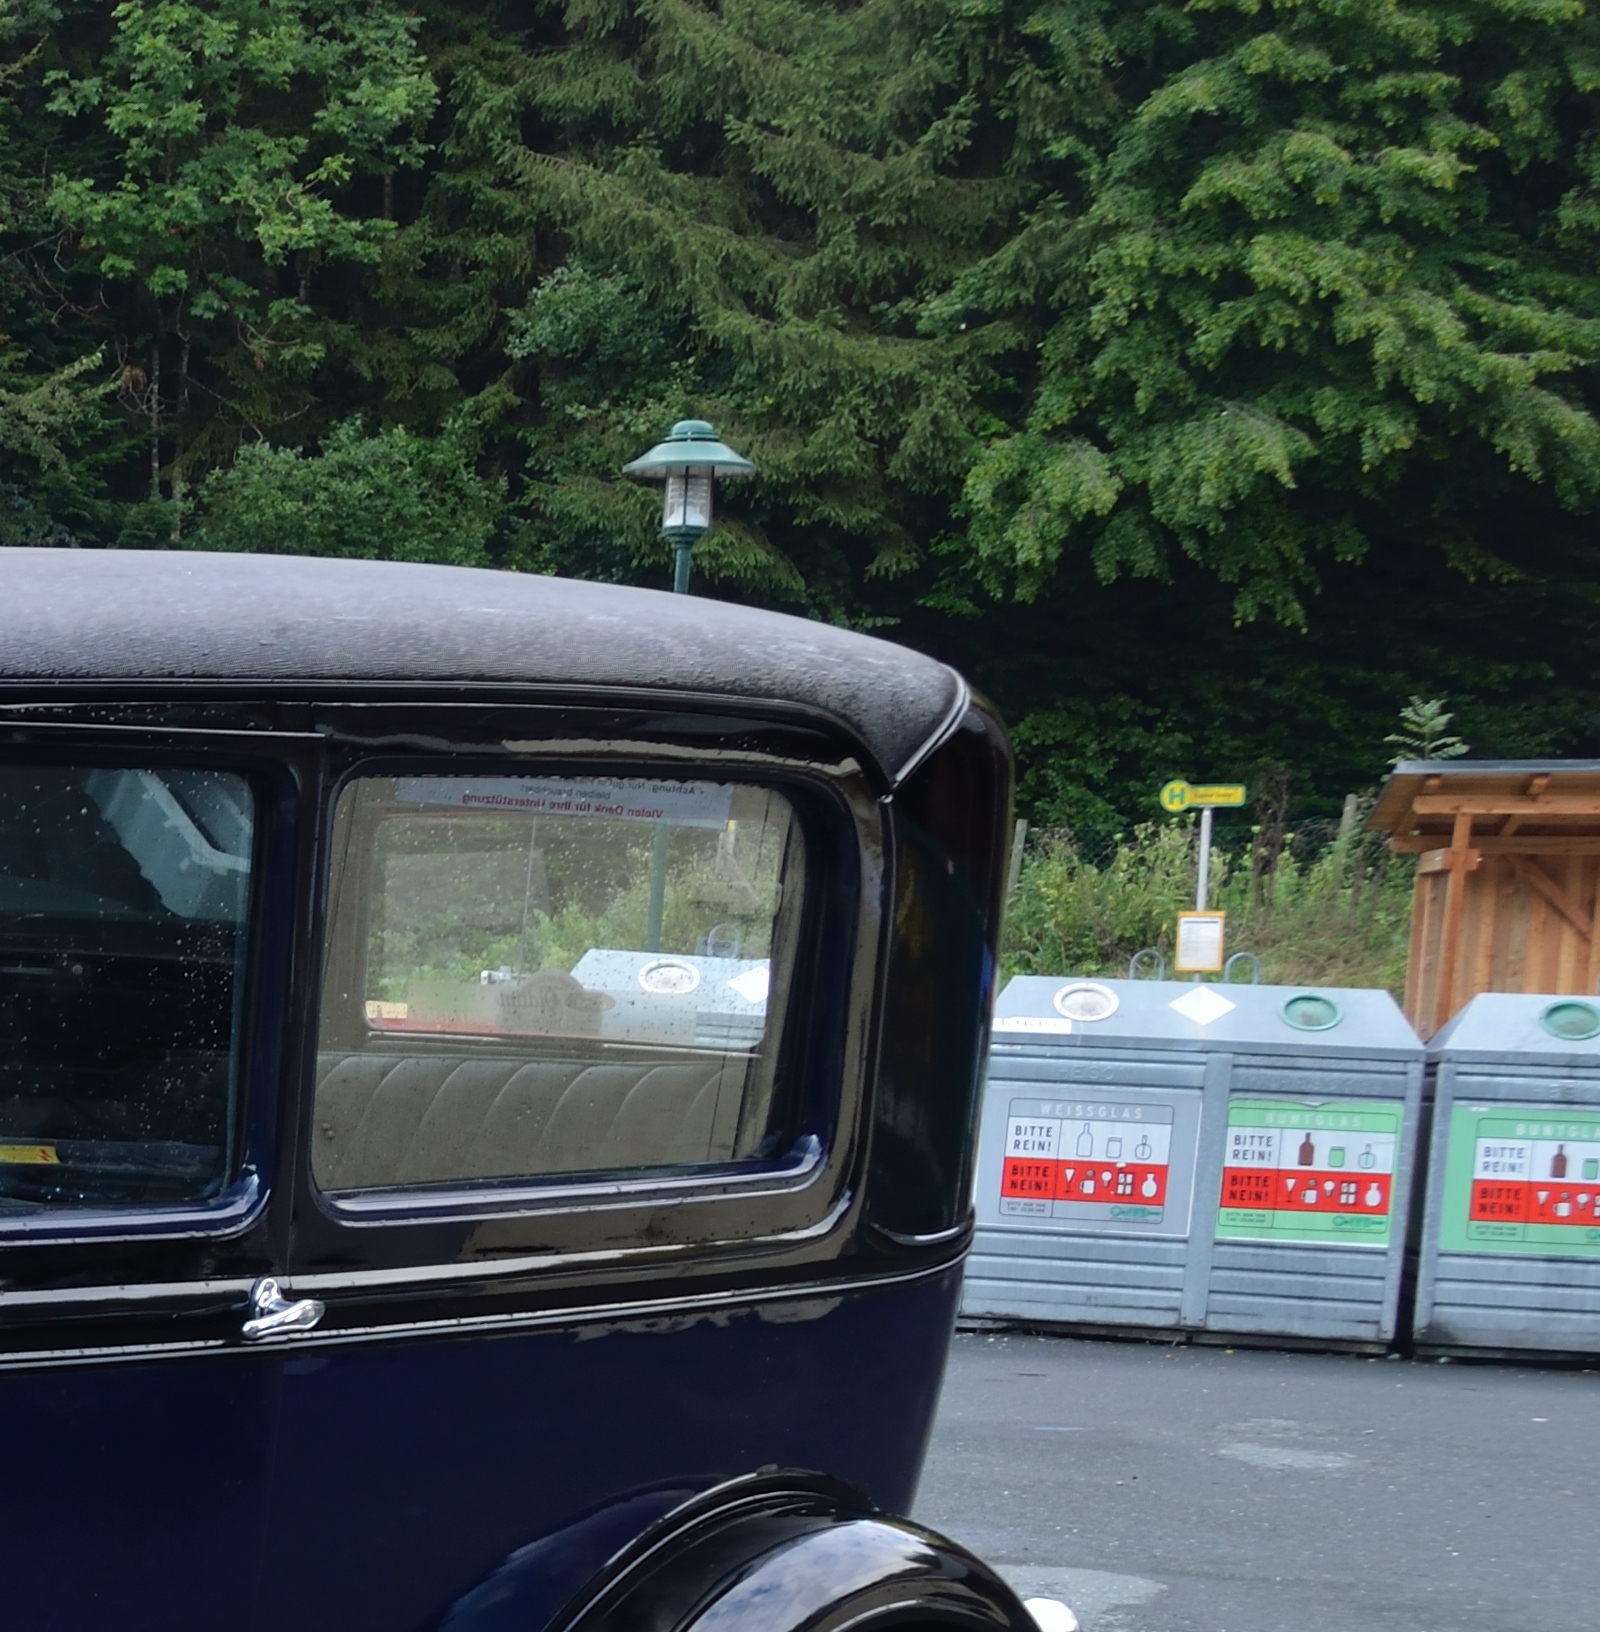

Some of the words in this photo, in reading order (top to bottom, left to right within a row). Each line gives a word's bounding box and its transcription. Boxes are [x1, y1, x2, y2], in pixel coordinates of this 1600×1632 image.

[1169, 788, 1185, 805] H
[1041, 1103, 1143, 1120] WEISSGLAS
[1264, 1112, 1362, 1127] BUNTGLAS
[1015, 1125, 1052, 1138] BITTE
[1013, 1139, 1051, 1152] REIN!
[1233, 1134, 1273, 1147] BITTE
[1232, 1149, 1272, 1161] REIN!
[1483, 1146, 1525, 1159] BITTE
[1011, 1165, 1049, 1178] BITTE
[1482, 1161, 1524, 1173] REIN!
[1009, 1179, 1048, 1192] NEIN!
[1230, 1175, 1270, 1187] BITTE
[1228, 1189, 1268, 1202] NEIN!
[1480, 1187, 1521, 1200] BITTE
[1478, 1202, 1520, 1215] NEIN!
